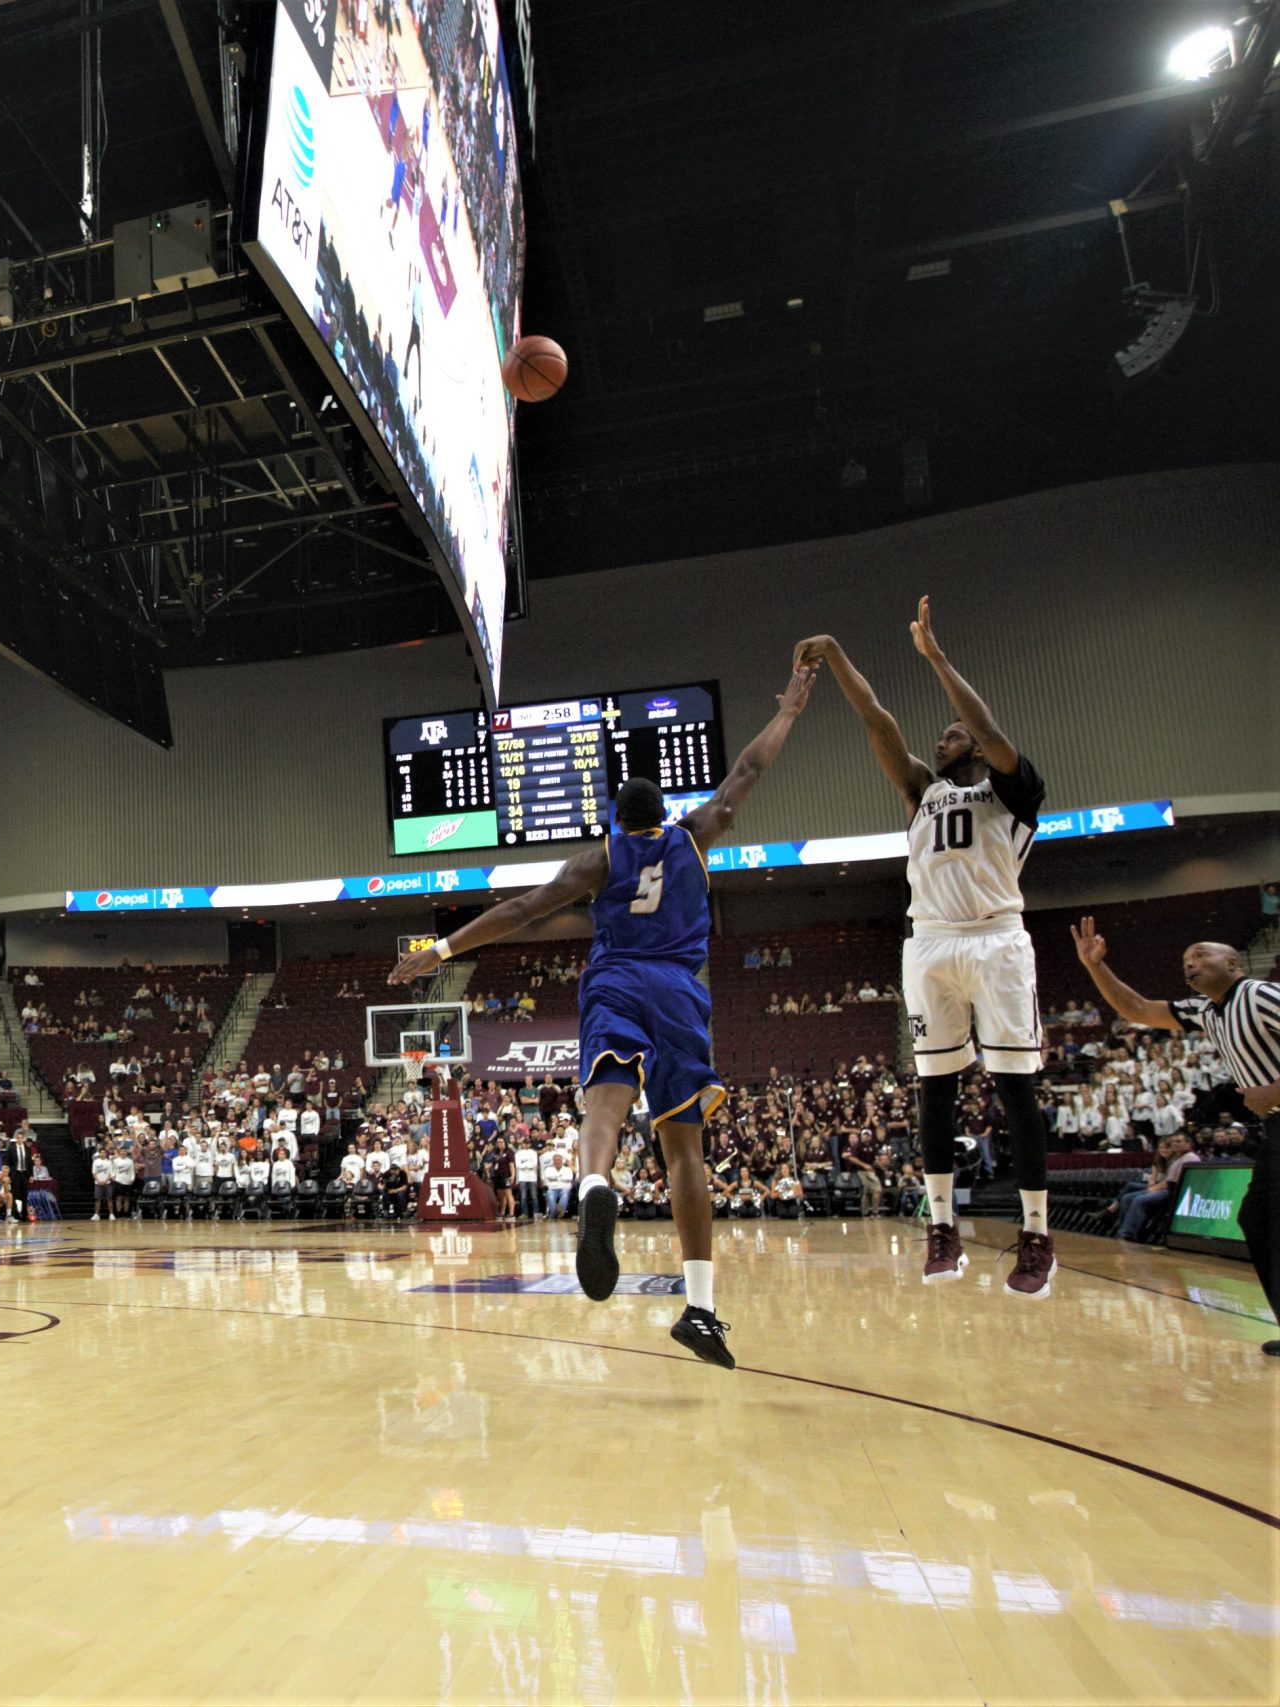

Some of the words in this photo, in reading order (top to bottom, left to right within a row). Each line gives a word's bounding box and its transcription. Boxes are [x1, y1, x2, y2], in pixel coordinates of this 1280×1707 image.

[271, 177, 313, 259] AT&T
[493, 713, 509, 726] 77
[542, 707, 571, 721] 2:58
[500, 752, 524, 763] 11/21
[621, 753, 627, 762] 1
[660, 748, 667, 757] 7
[702, 744, 708, 753] 1
[688, 756, 695, 764] 1
[702, 754, 709, 763] 1
[572, 757, 599, 770] 10/14
[689, 766, 696, 775] 1
[405, 775, 411, 783] 1
[445, 780, 451, 788] 7
[582, 771, 592, 783] 8
[690, 775, 697, 785] 1
[704, 774, 710, 783] 1
[508, 792, 520, 804] 11
[582, 785, 594, 797] 11
[508, 805, 524, 817] 34
[581, 798, 597, 811] 32
[920, 792, 957, 817] TEXAS
[963, 791, 994, 803] A&M
[509, 819, 523, 831] 12
[582, 812, 597, 825] 12
[933, 808, 973, 853] 10
[386, 876, 423, 893] pepsi
[114, 892, 149, 907] pepsi
[441, 1109, 450, 1148] TEXAS
[1190, 1193, 1233, 1220] REGIONS
